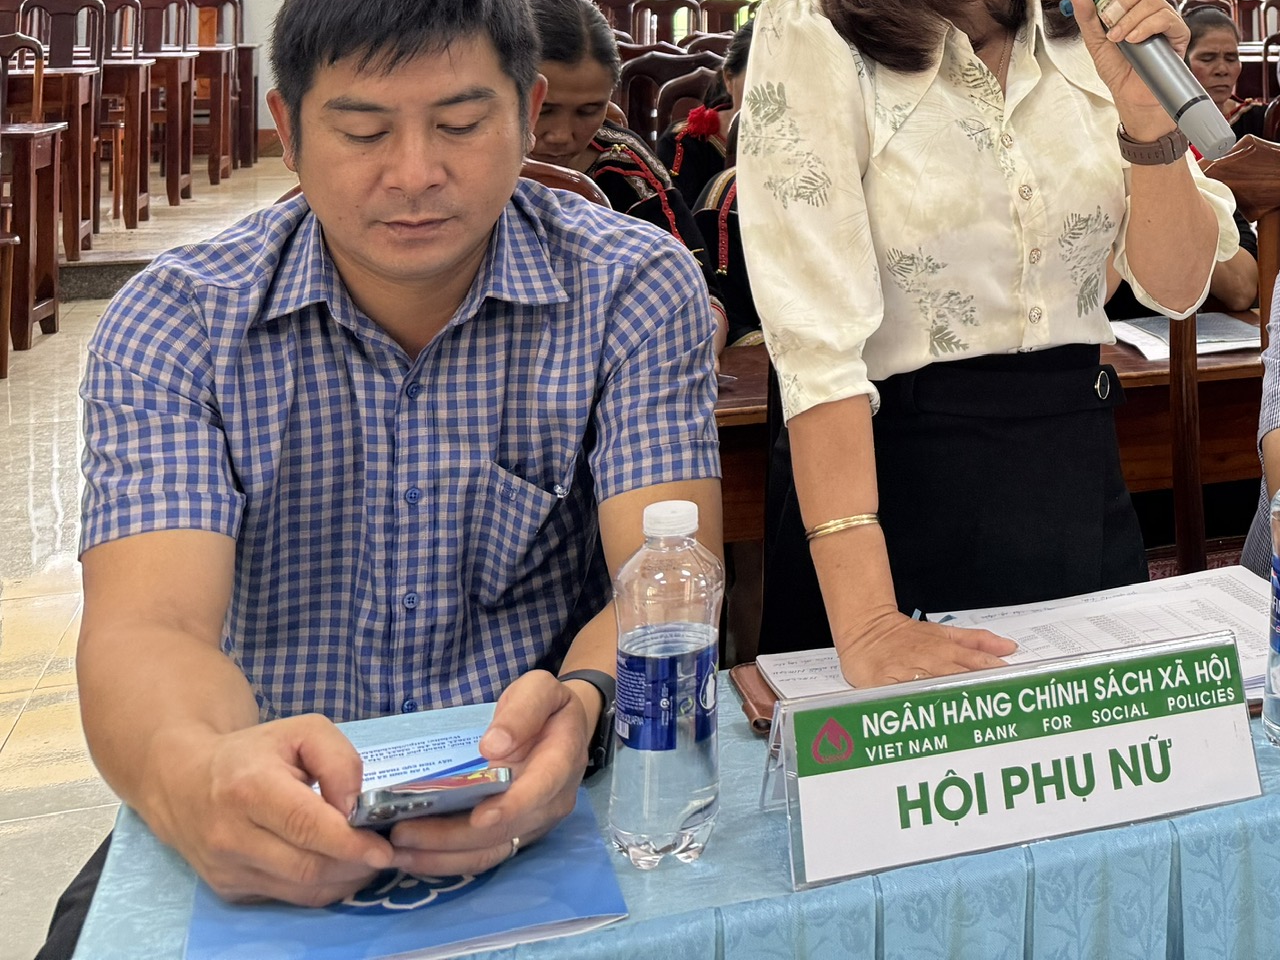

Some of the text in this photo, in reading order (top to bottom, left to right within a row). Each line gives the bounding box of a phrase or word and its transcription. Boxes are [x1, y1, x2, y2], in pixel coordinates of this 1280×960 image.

[861, 652, 1232, 738] NGÂN HÀNG CHÍNH SÁCH XÃ HỘI
[973, 723, 1018, 743] BANK
[1043, 714, 1073, 733] FOR
[1092, 702, 1149, 724] SOCIAL
[1167, 686, 1236, 713] POLICIES
[896, 732, 1173, 830] HỘI PHỤ NỮ
